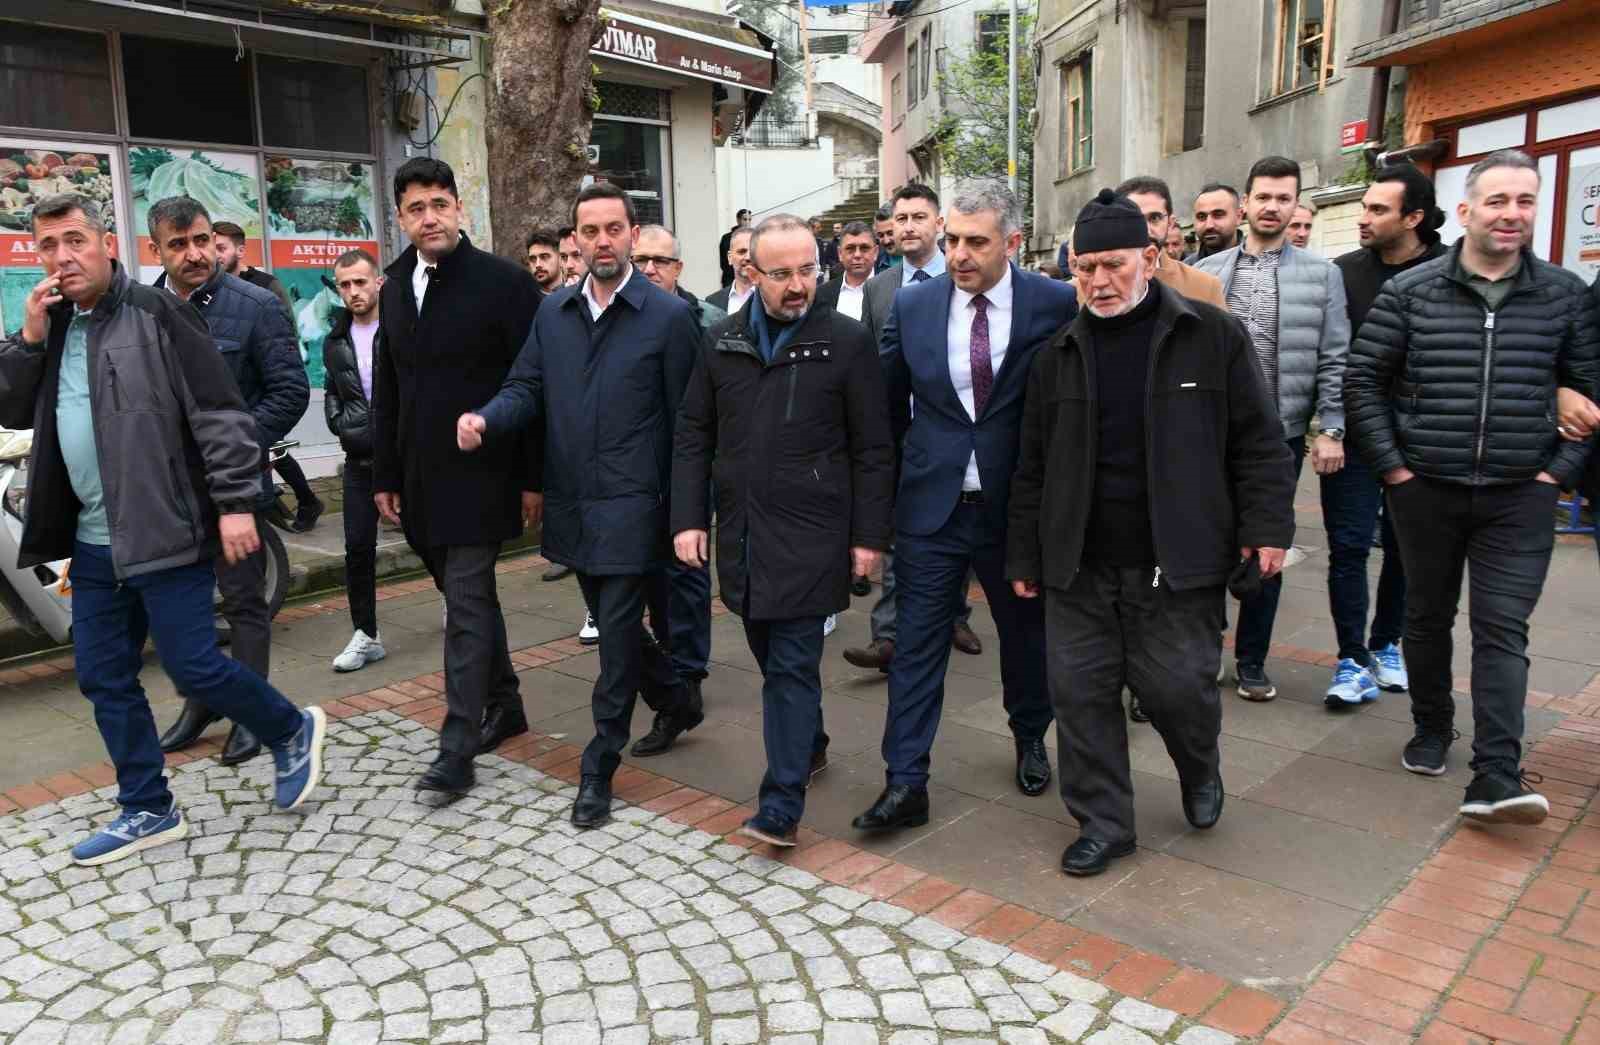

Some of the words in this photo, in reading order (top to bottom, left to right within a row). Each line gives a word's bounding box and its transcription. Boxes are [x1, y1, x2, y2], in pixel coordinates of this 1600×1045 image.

[592, 20, 658, 62] VİMAR
[680, 55, 691, 68] Av
[692, 58, 699, 70] &
[700, 60, 722, 75] Marin
[723, 65, 742, 81] Shop
